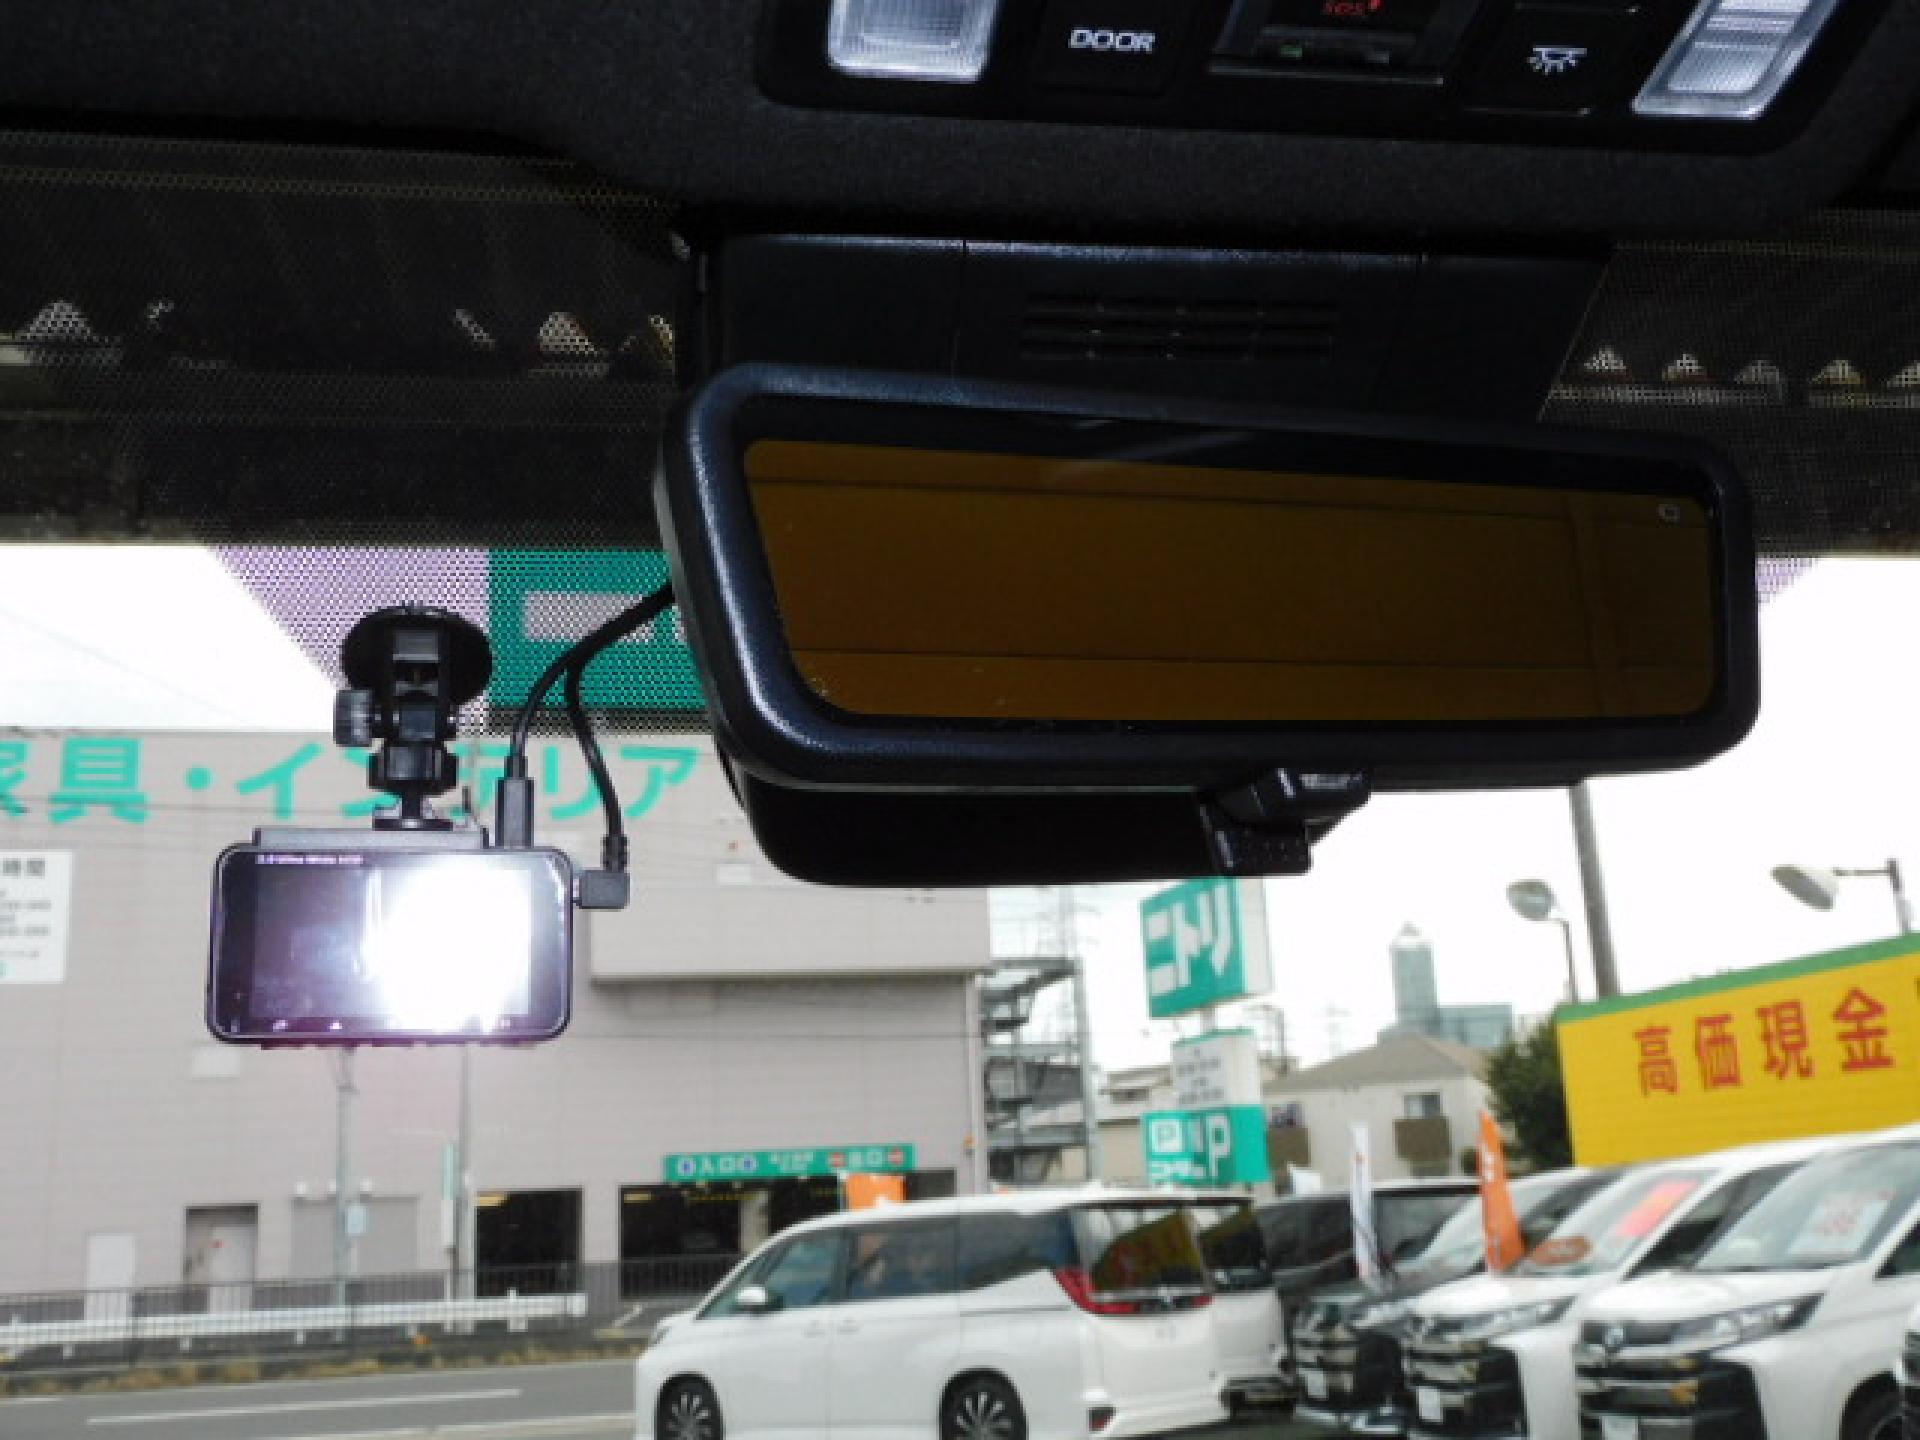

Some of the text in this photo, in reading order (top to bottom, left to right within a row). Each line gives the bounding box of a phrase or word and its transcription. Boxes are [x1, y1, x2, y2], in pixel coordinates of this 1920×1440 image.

[1069, 27, 1156, 53] DOOR
[1148, 883, 1232, 997] ニトリ
[1633, 986, 1894, 1095] 高価現金
